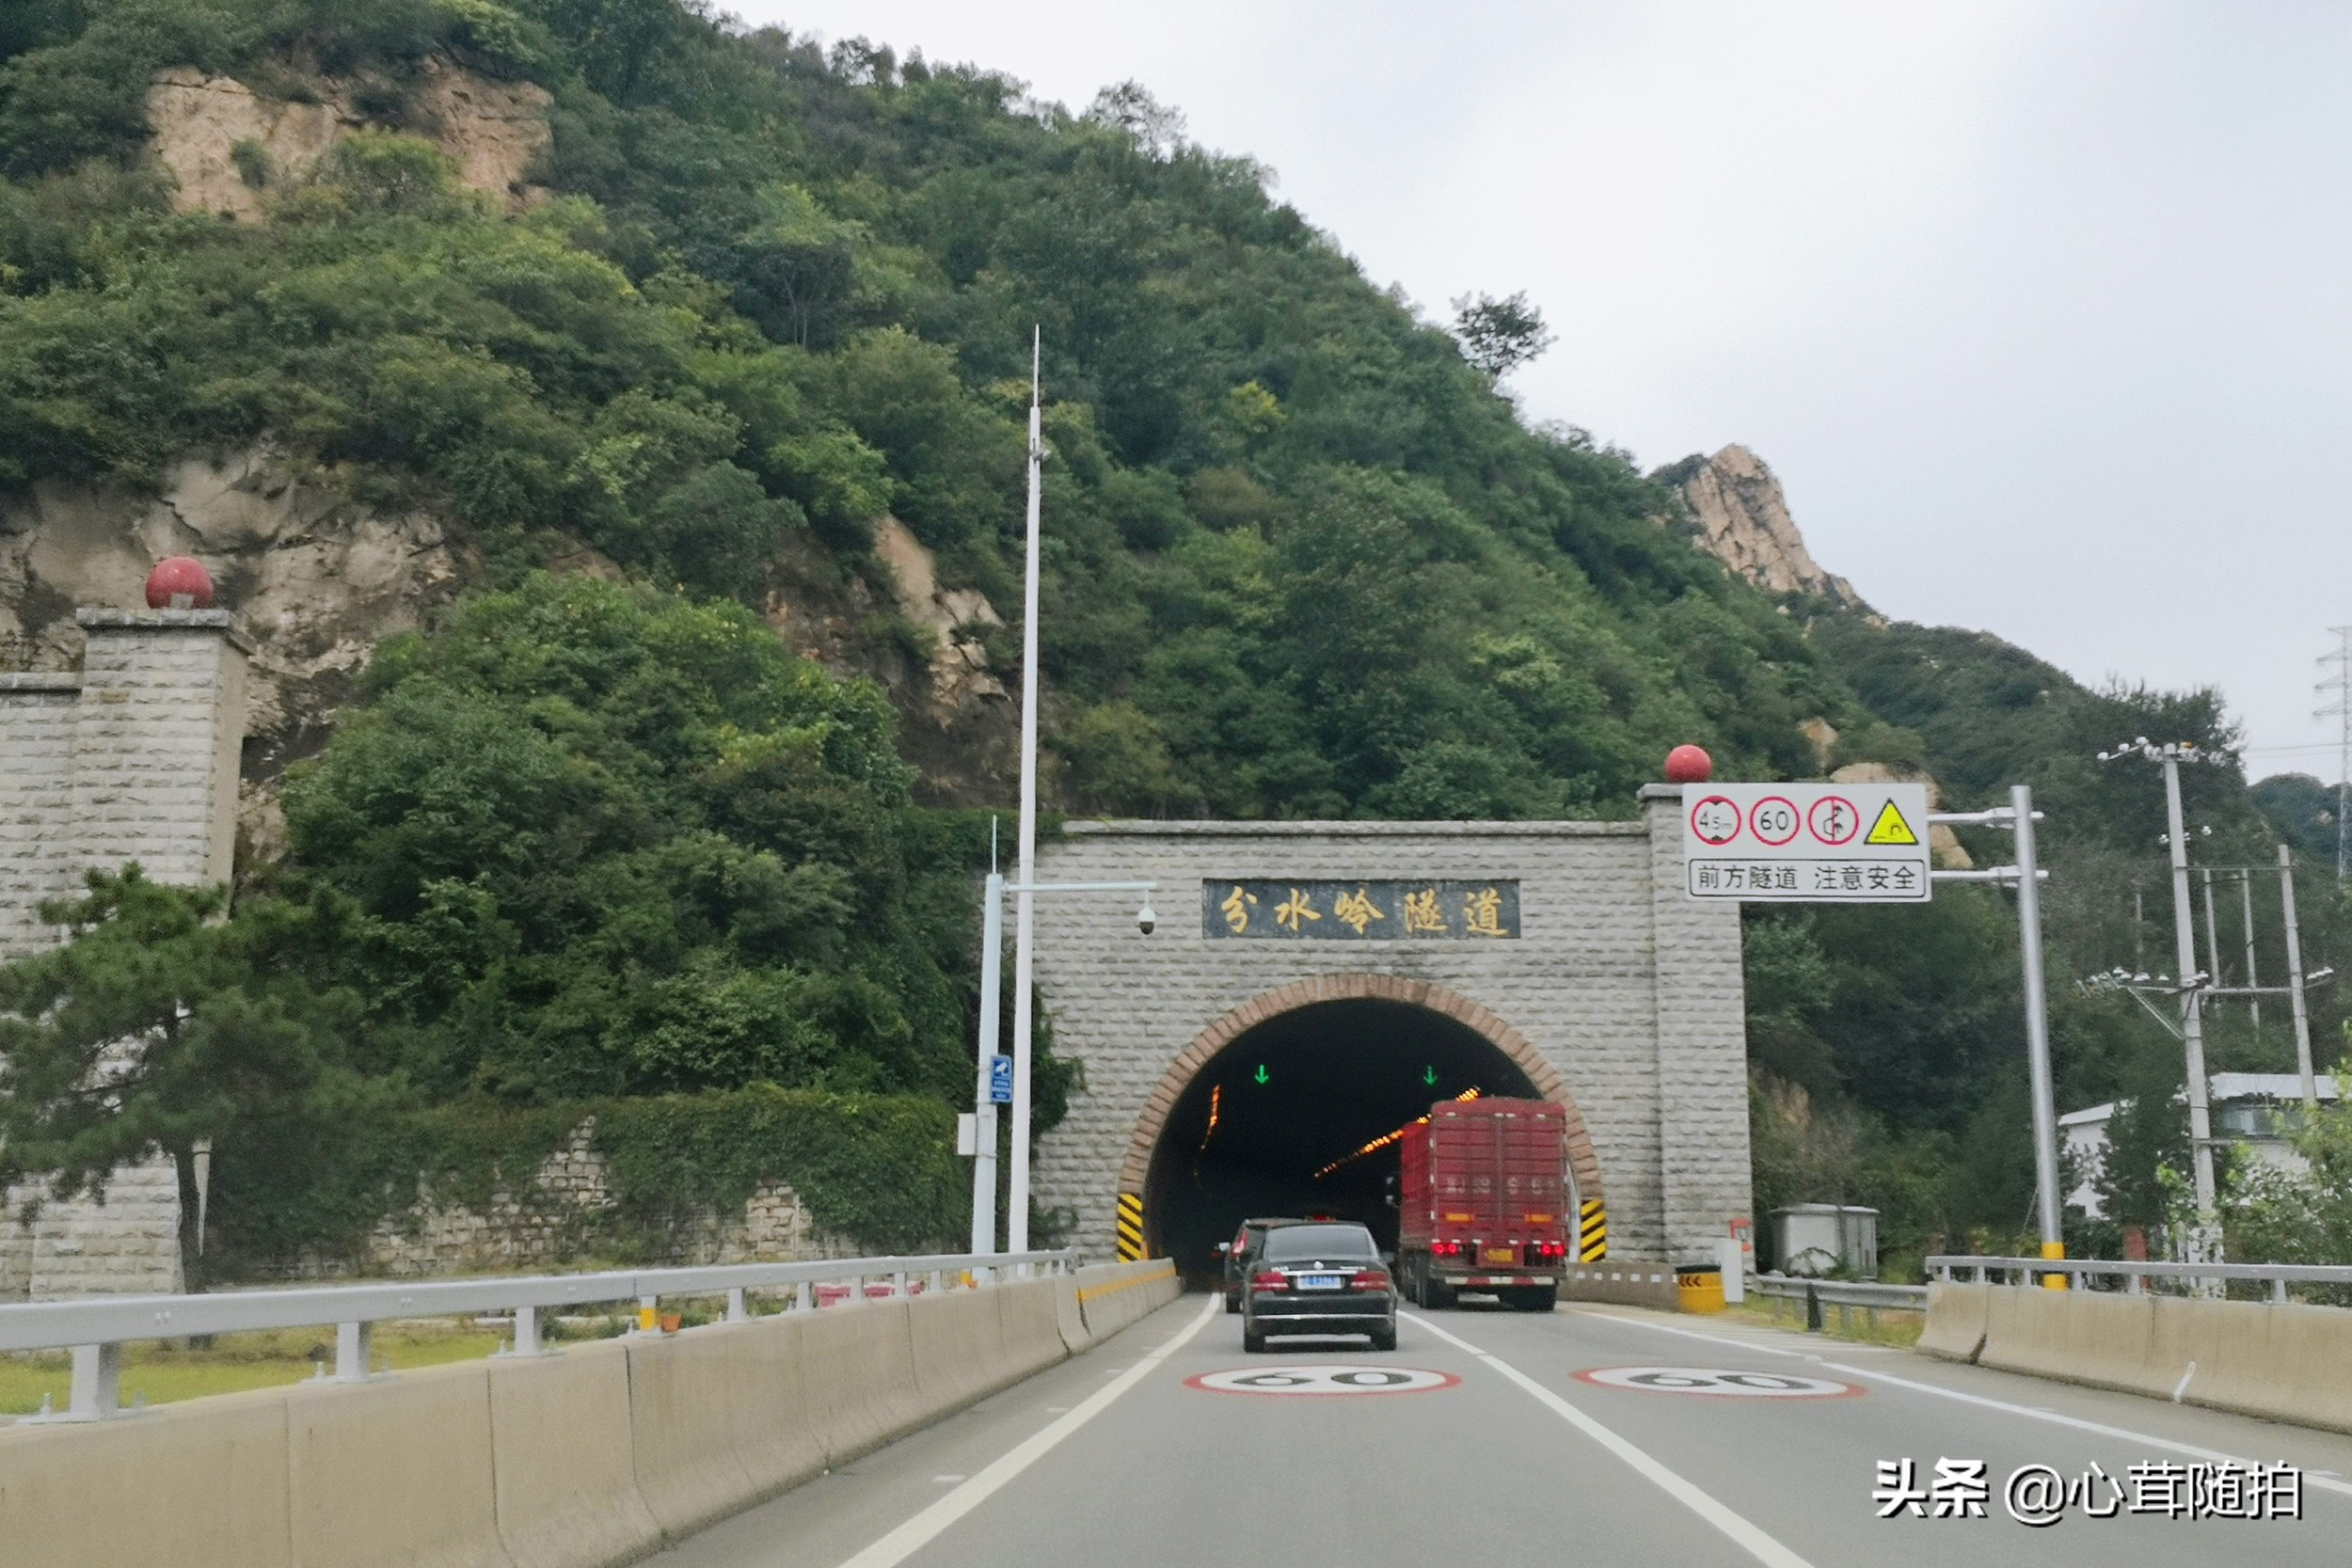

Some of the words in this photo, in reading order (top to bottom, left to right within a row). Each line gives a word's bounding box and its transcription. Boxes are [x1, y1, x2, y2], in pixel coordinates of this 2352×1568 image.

[1760, 811, 1788, 831] 60
[1697, 864, 1798, 890] 前方隧道
[1815, 864, 1915, 890] 注意安全
[1221, 885, 1509, 936] 分水岭隧道
[1232, 1370, 1413, 1386] 60
